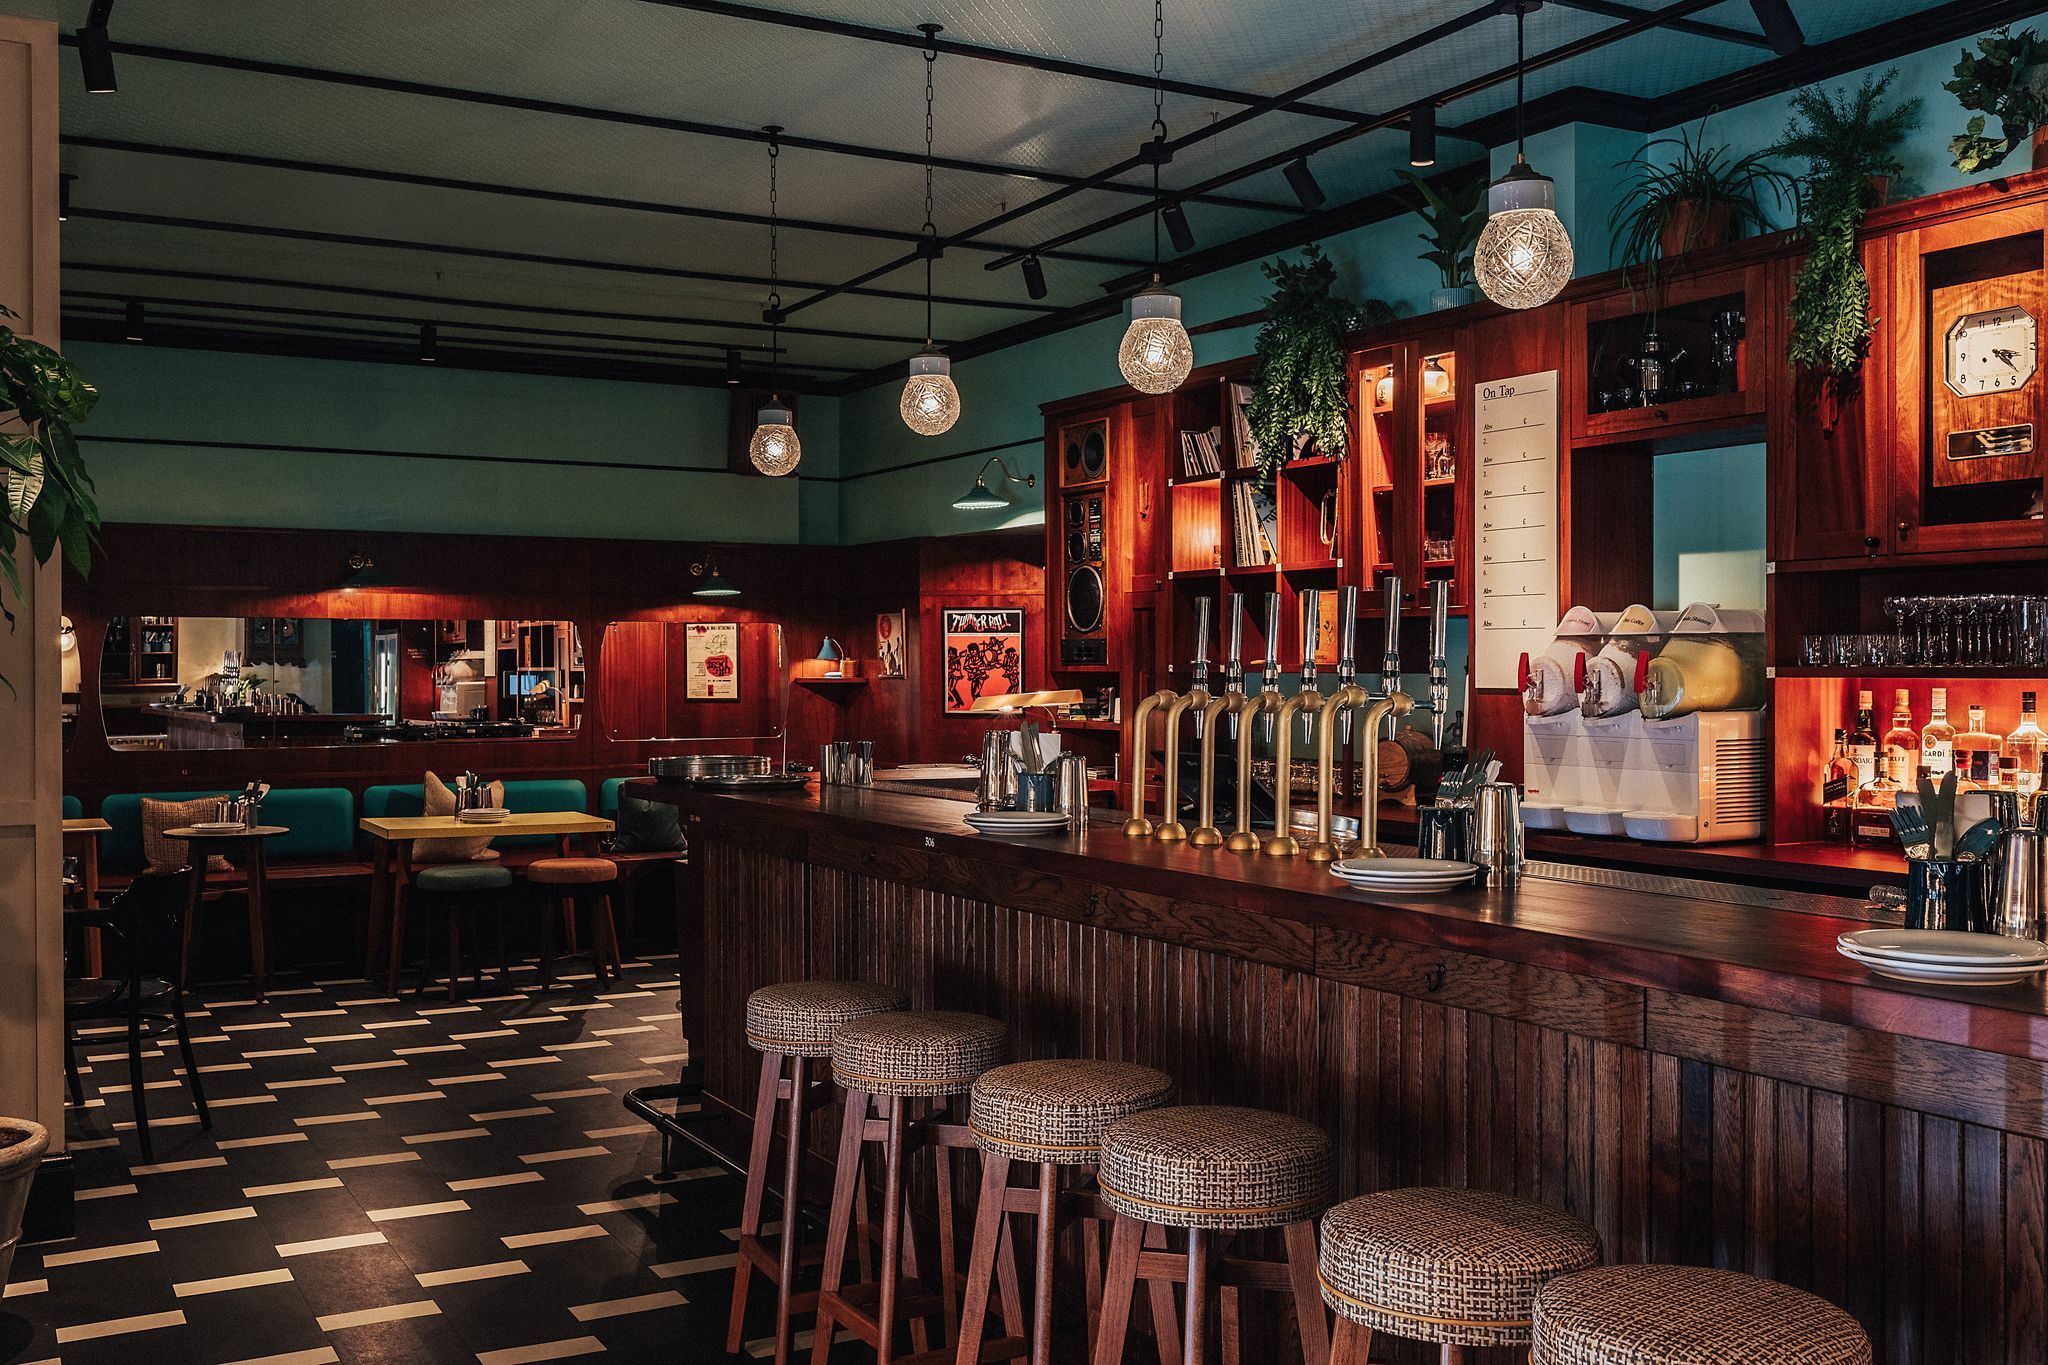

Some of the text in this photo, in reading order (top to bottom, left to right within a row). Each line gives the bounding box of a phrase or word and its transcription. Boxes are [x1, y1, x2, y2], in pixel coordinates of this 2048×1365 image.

[1978, 314, 2015, 328] 11 12 1
[1961, 353, 1966, 361] 9
[1960, 374, 1966, 384] 8
[1979, 376, 2016, 390] 7 6 5
[1483, 385, 1515, 399] On Tap
[1922, 749, 1945, 757] CARDÍ
[924, 836, 935, 848] 306
